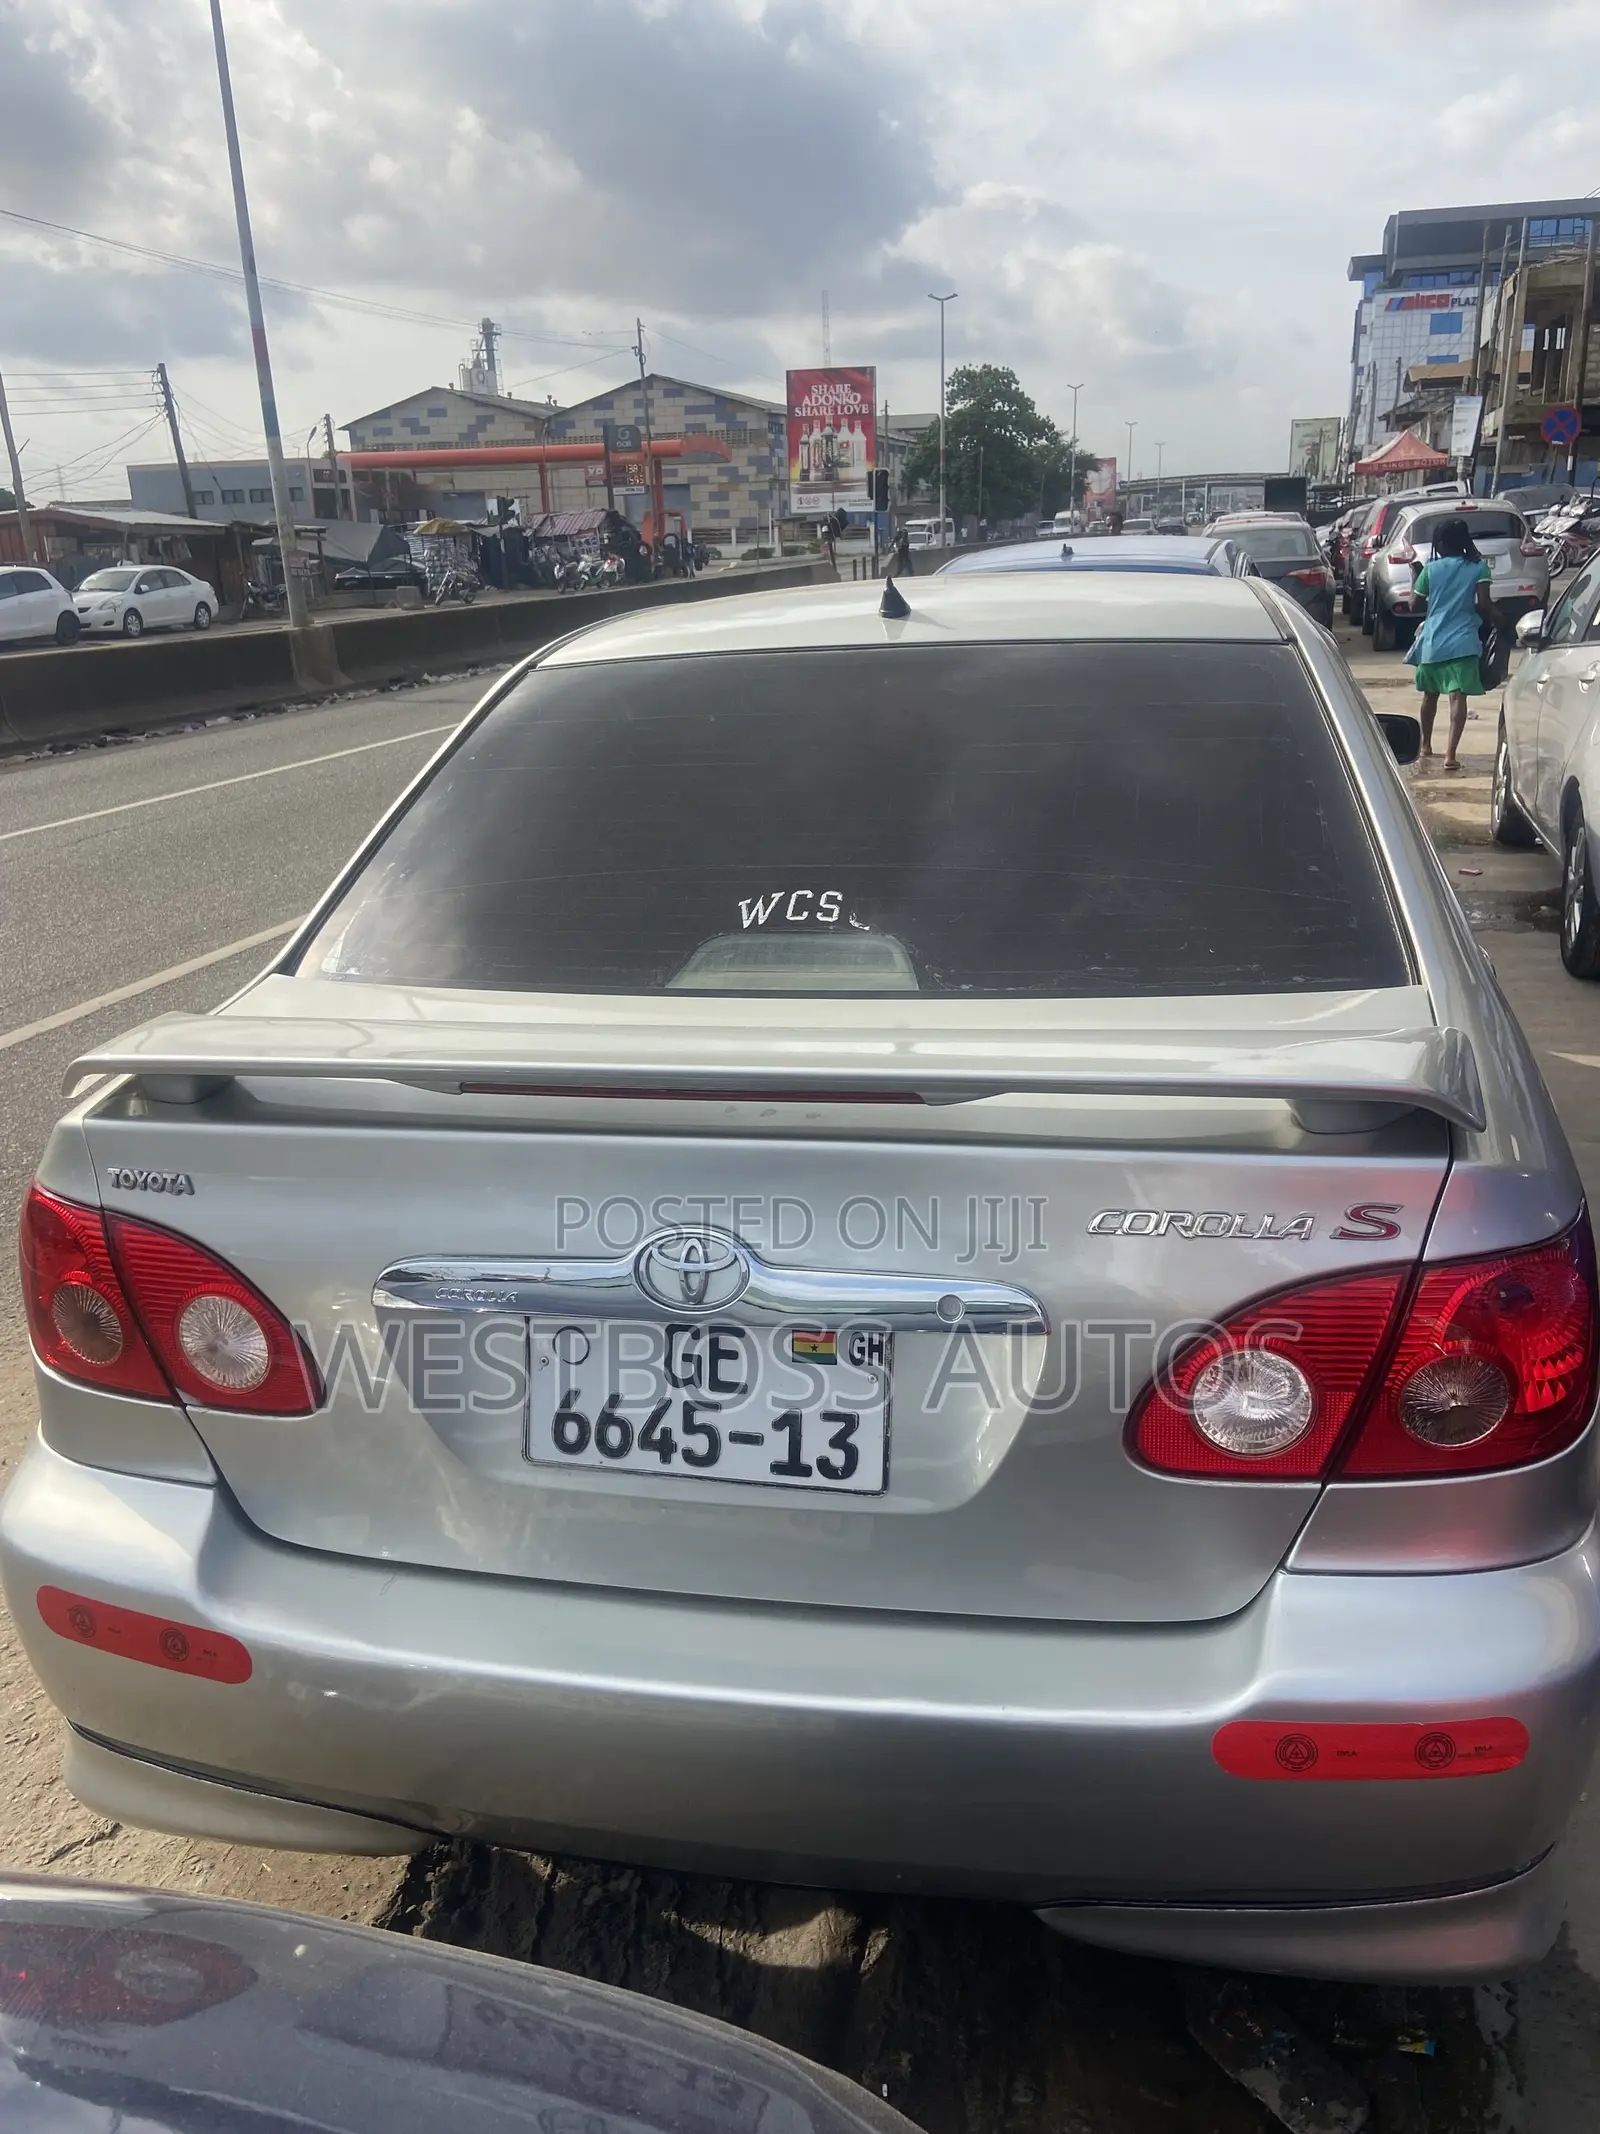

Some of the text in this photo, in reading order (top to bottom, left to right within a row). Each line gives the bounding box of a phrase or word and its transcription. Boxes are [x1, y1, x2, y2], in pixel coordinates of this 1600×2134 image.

[1451, 297, 1479, 307] PLAZ
[802, 393, 861, 407] ADONKO
[811, 384, 852, 394] SHARE
[795, 404, 869, 417] SHARE LOVE
[737, 889, 870, 931] WCS
[107, 1167, 195, 1195] TOYOTA
[1087, 1202, 1405, 1241] COROLLA S
[435, 1287, 518, 1303] COROLLA
[664, 1323, 749, 1394] GE
[849, 1331, 884, 1367] GH
[551, 1388, 860, 1480] 6645-13
